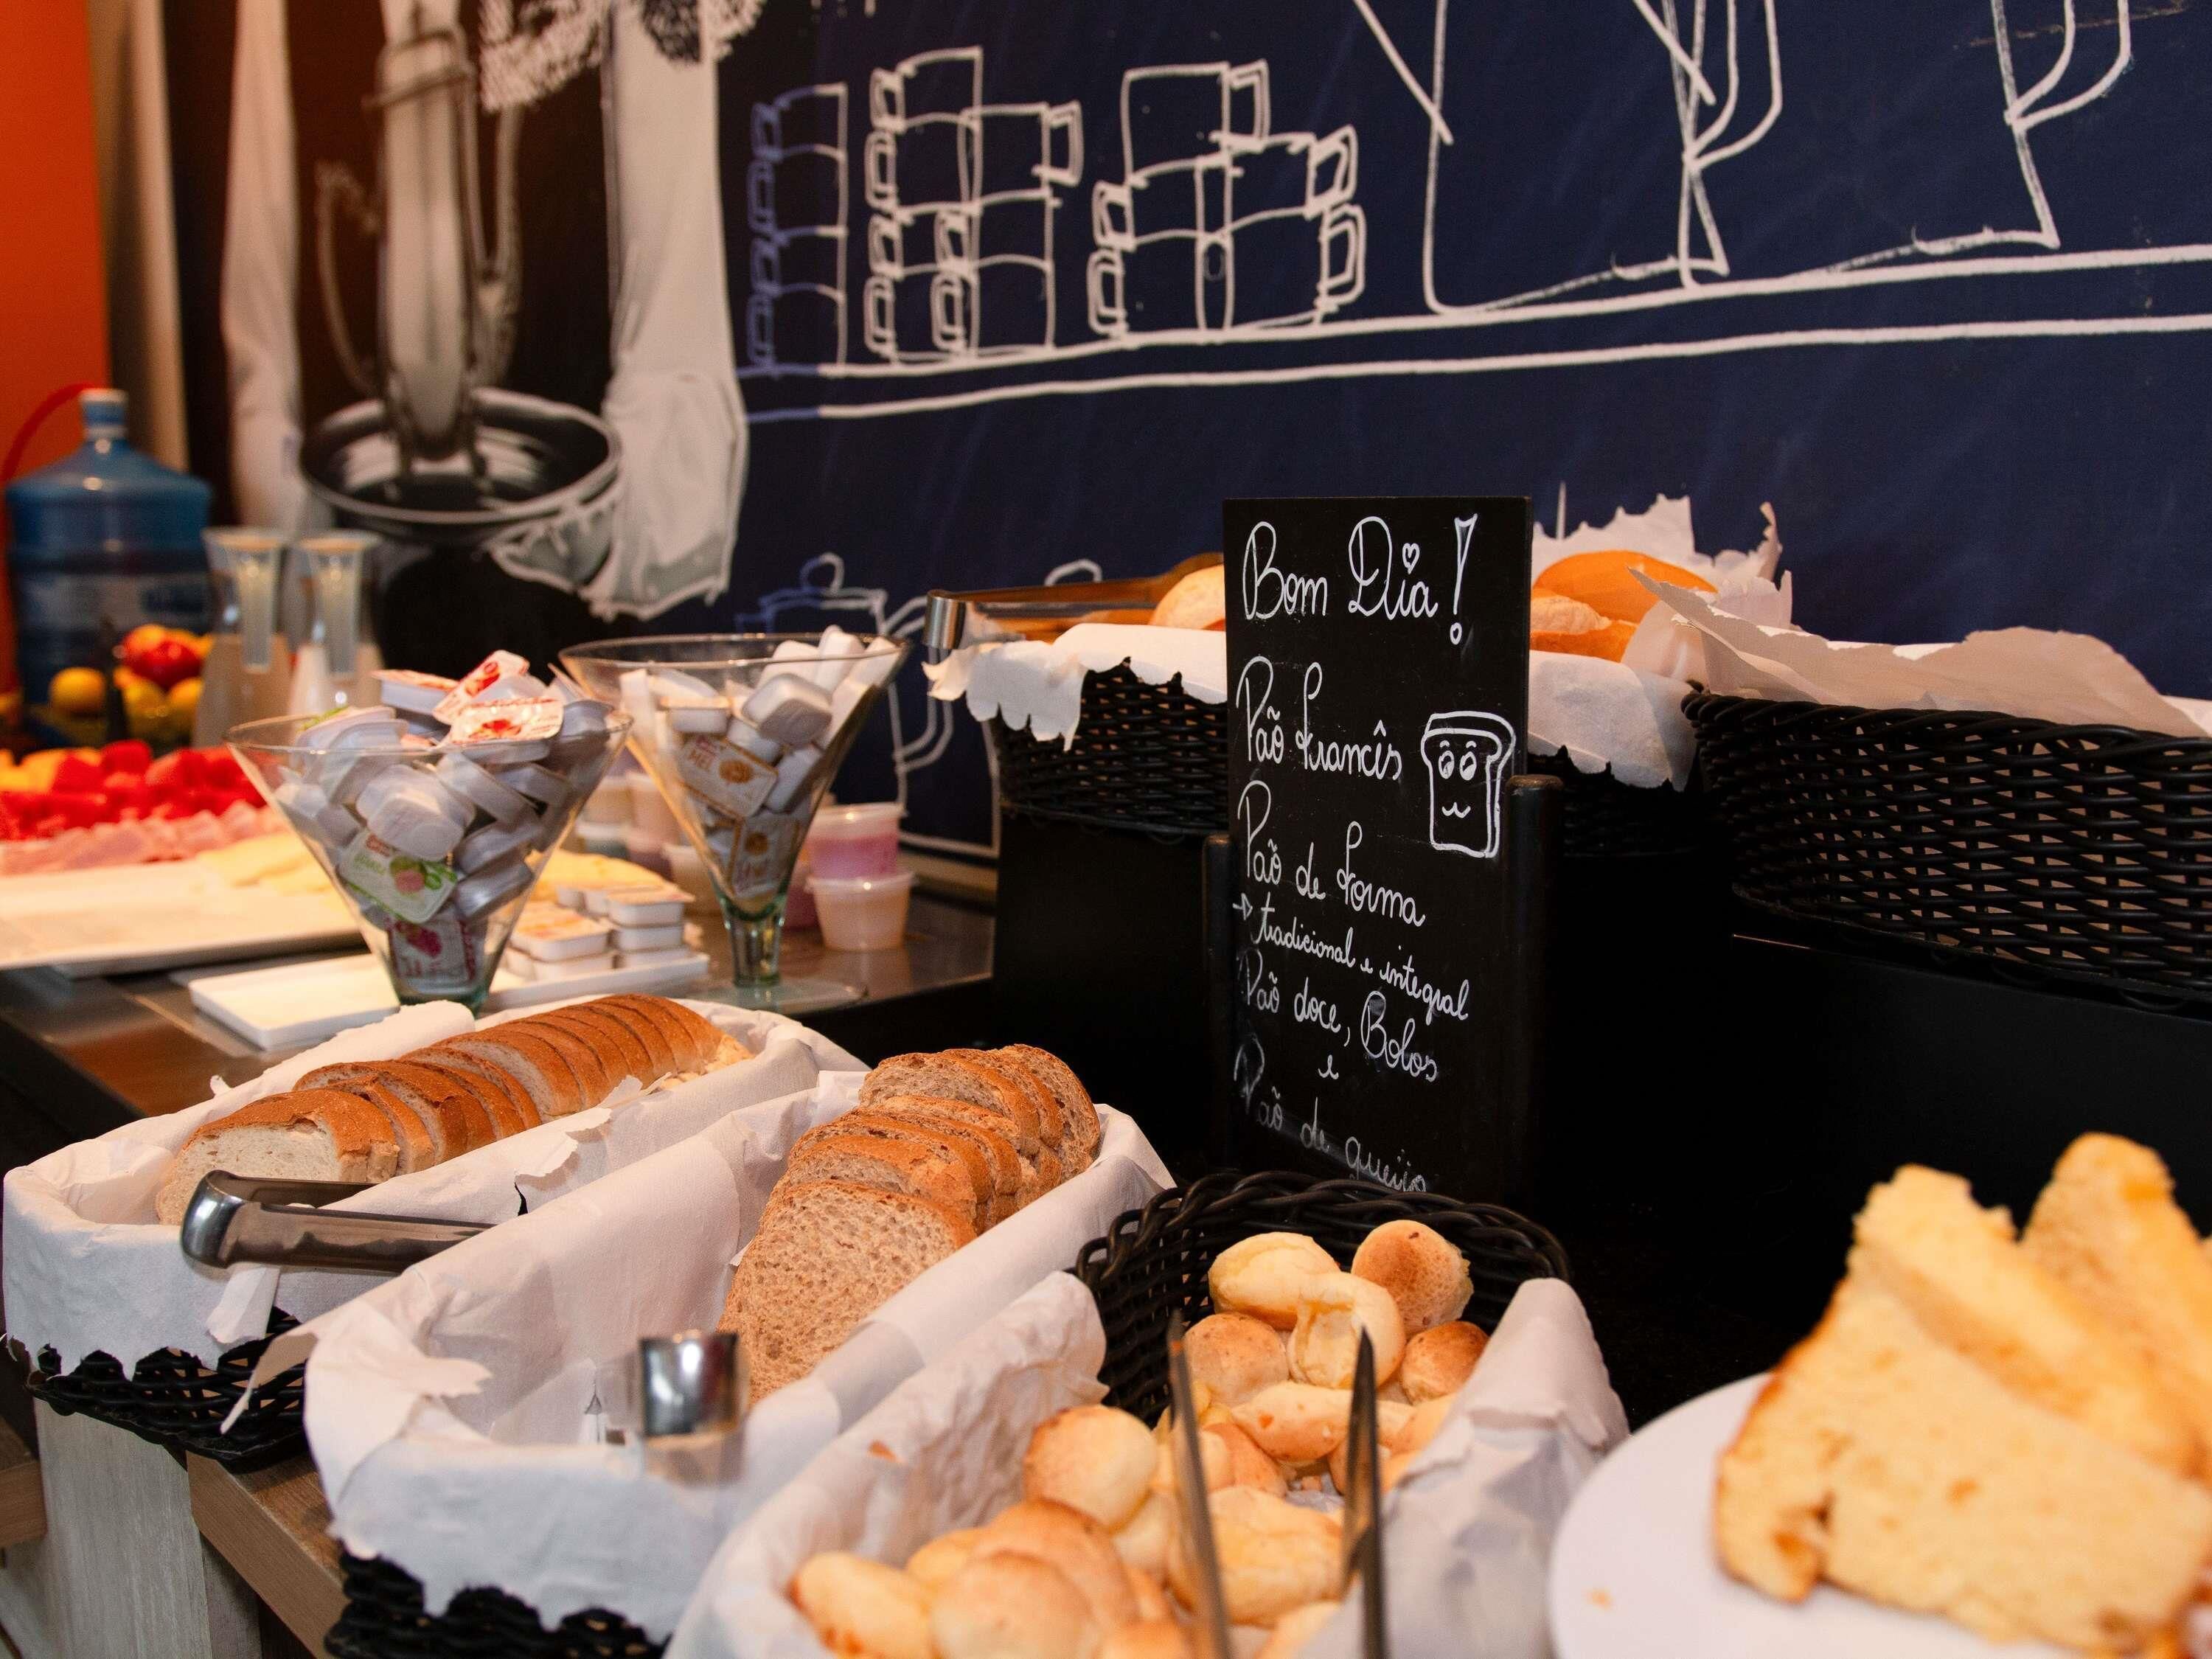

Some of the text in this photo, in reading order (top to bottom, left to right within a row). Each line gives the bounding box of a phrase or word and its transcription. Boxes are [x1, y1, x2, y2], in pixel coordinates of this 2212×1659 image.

[1242, 521, 1328, 620] Bom
[1295, 841, 1326, 900] de
[1251, 891, 1356, 968] tradicional
[1379, 945, 1470, 1026] integral
[1360, 990, 1439, 1082] Bolos
[1300, 1096, 1330, 1152] de
